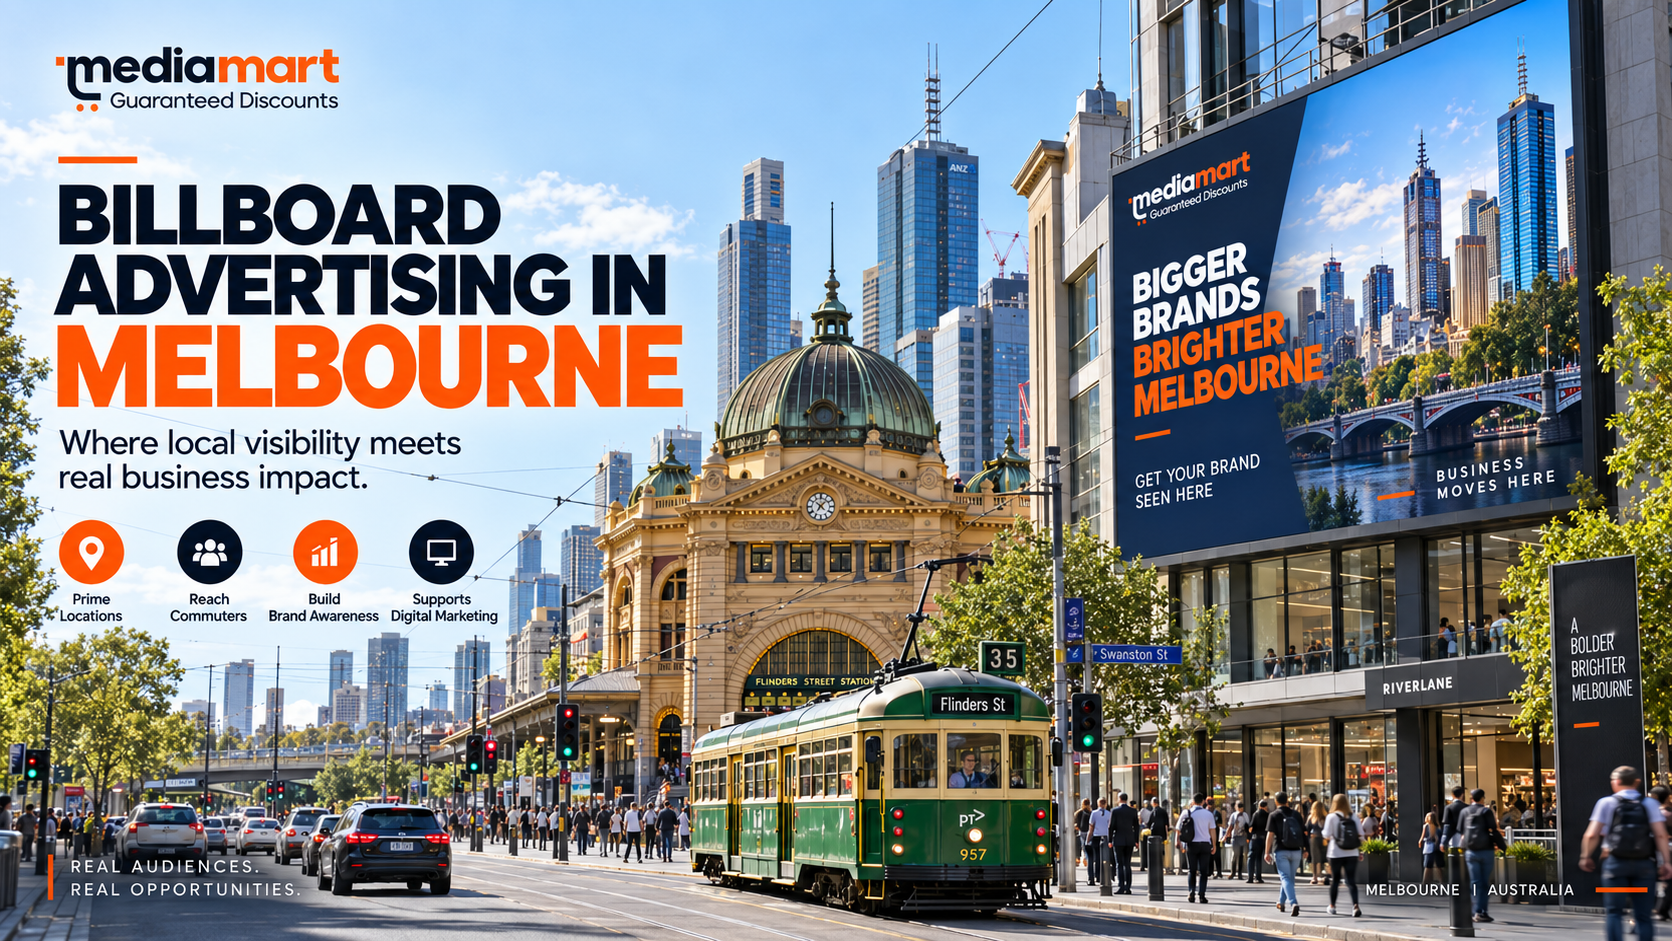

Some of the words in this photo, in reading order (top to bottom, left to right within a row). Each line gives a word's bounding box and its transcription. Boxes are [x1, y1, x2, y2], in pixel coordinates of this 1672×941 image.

[949, 163, 969, 174] ANZ
[1132, 151, 1251, 220] mediamart
[1149, 193, 1202, 220] Guaranteed
[1203, 179, 1249, 202] Discounts
[1132, 242, 1248, 305] BIGGER
[1132, 276, 1261, 341] BRANDS
[1133, 310, 1286, 379] BRIGHTER
[1134, 343, 1324, 418] MELBOURNE
[1135, 470, 1162, 489] GET
[1166, 463, 1206, 483] YOUR
[1210, 453, 1261, 476] BRAND
[1436, 456, 1524, 483] BUSINESS
[1135, 489, 1171, 509] SEEN
[1176, 482, 1213, 502] HERE
[1437, 479, 1497, 500] MOVES
[1508, 469, 1555, 489] HERE
[1570, 617, 1579, 634] A
[1100, 648, 1153, 660] Swanston
[1156, 649, 1168, 660] St
[1570, 632, 1615, 655] BOLDER
[990, 648, 1017, 669] 35
[1571, 655, 1626, 678] BRIGHTER
[755, 677, 798, 686] FLINDERS
[803, 677, 835, 686] STREET
[1383, 676, 1453, 695] RIVERLANE
[1572, 679, 1633, 702] MELBOURNE
[940, 697, 988, 712] Flinders
[993, 697, 1006, 712] St
[960, 848, 987, 861] 957
